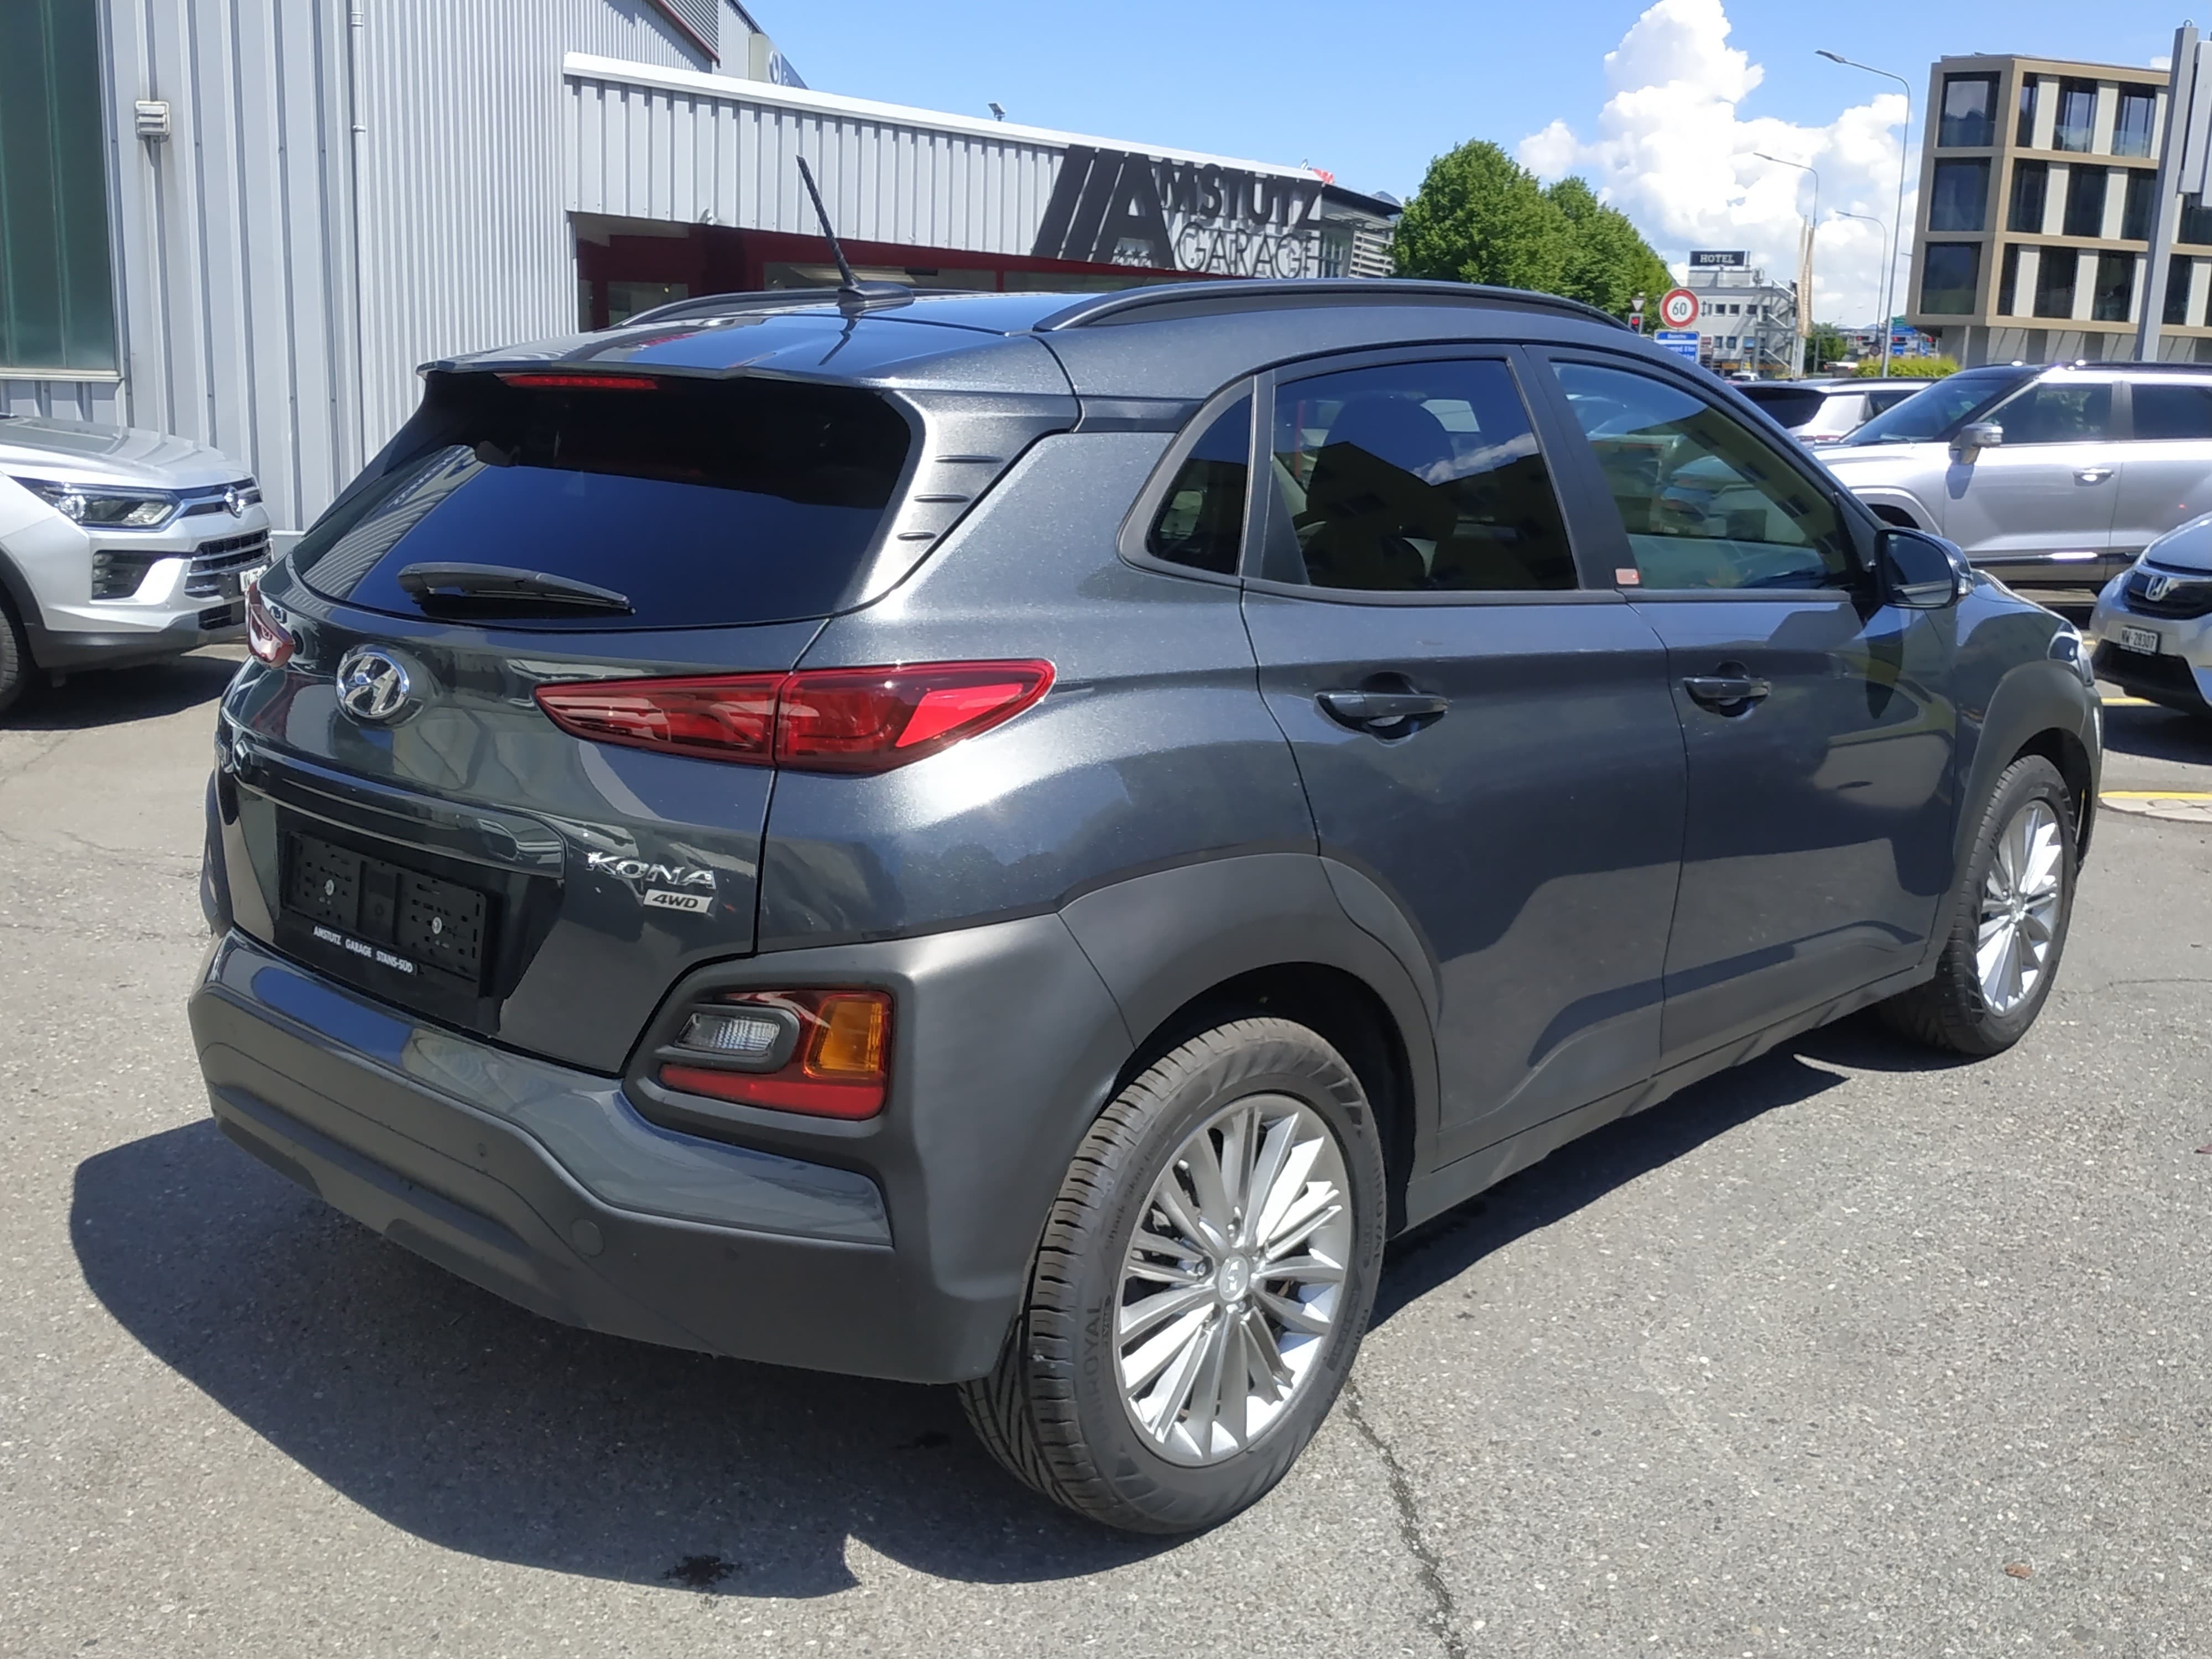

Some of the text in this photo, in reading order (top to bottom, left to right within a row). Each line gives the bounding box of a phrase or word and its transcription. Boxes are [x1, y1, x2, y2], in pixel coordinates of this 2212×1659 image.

[1089, 150, 1322, 269] AMSTUTZ
[1176, 221, 1322, 278] GARAGE
[1700, 254, 1735, 264] HOTEL
[1672, 302, 1687, 316] 60
[586, 852, 716, 889] KONA
[652, 894, 698, 909] 4WD
[314, 926, 413, 973] AMSTUTZ GARAGE STANS-SÜD
